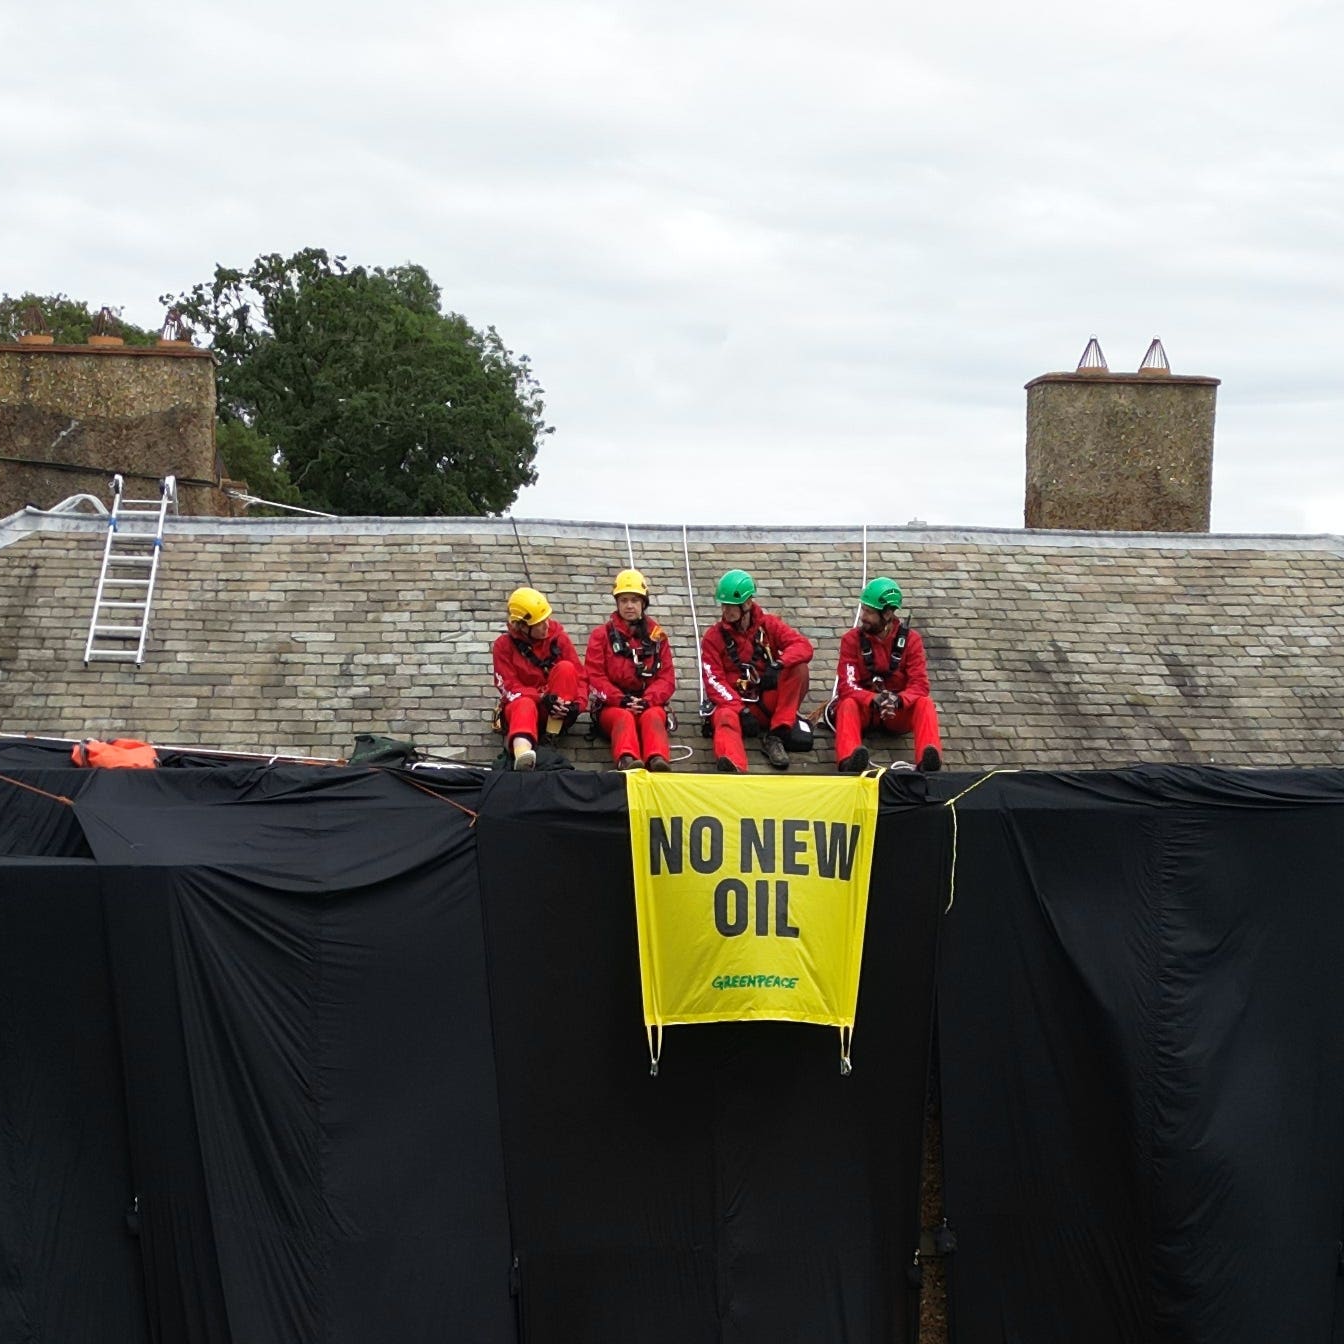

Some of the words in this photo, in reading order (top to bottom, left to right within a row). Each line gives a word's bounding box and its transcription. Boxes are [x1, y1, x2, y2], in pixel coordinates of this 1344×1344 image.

[649, 815, 724, 876] NO
[740, 818, 861, 882] NEW
[713, 878, 800, 938] OIL
[711, 974, 800, 991] GREENPEACE
